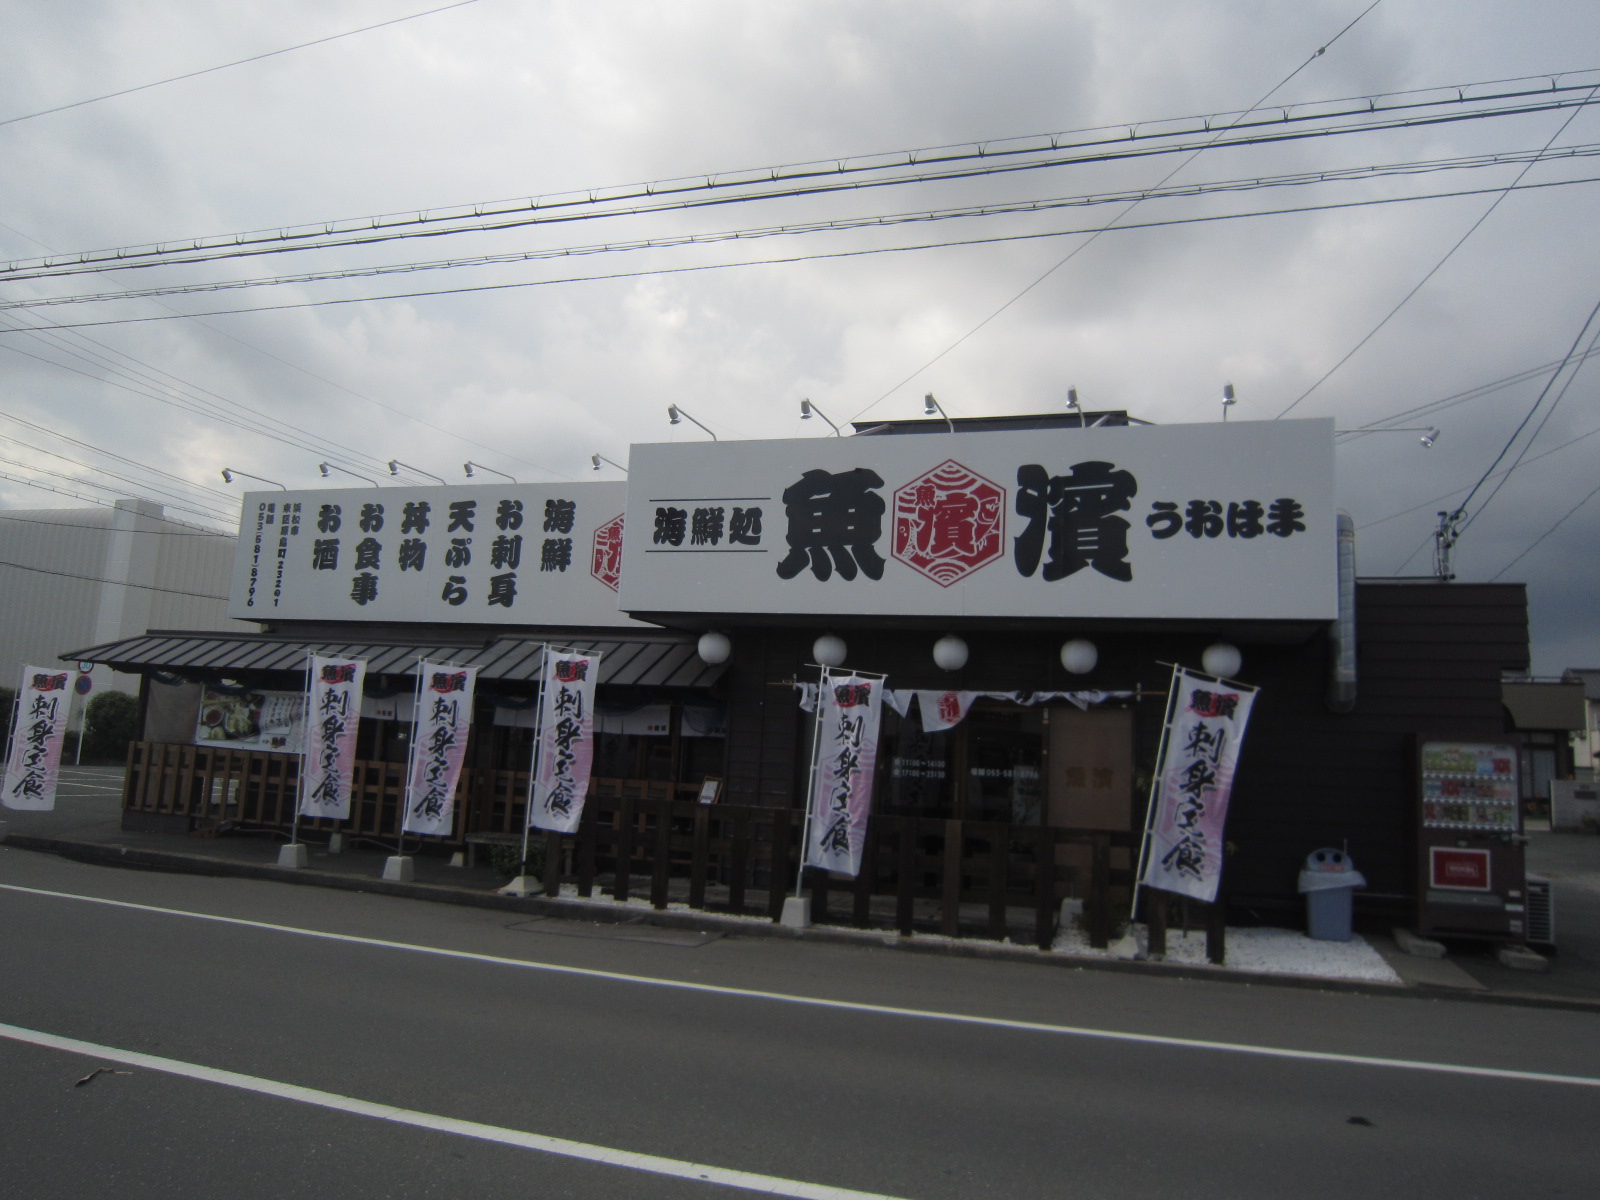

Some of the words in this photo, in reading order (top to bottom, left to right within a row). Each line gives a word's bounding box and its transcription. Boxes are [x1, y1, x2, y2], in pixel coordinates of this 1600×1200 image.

[312, 504, 342, 571] お酒
[351, 503, 384, 606] お食事
[399, 502, 430, 571] 丼物
[442, 500, 477, 606] 天ぷら
[488, 500, 524, 608] お刺身
[541, 499, 577, 572] 海鮮
[652, 507, 763, 546] 海鮮処
[1146, 498, 1306, 540] うおはま
[12, 694, 55, 797] 刺身定食
[312, 688, 349, 802] 刺身定食
[413, 697, 458, 818] 刺身定食
[544, 686, 581, 815] 刺身定食
[820, 713, 863, 852] 刺身定食
[1161, 721, 1225, 876] 刺身定食
